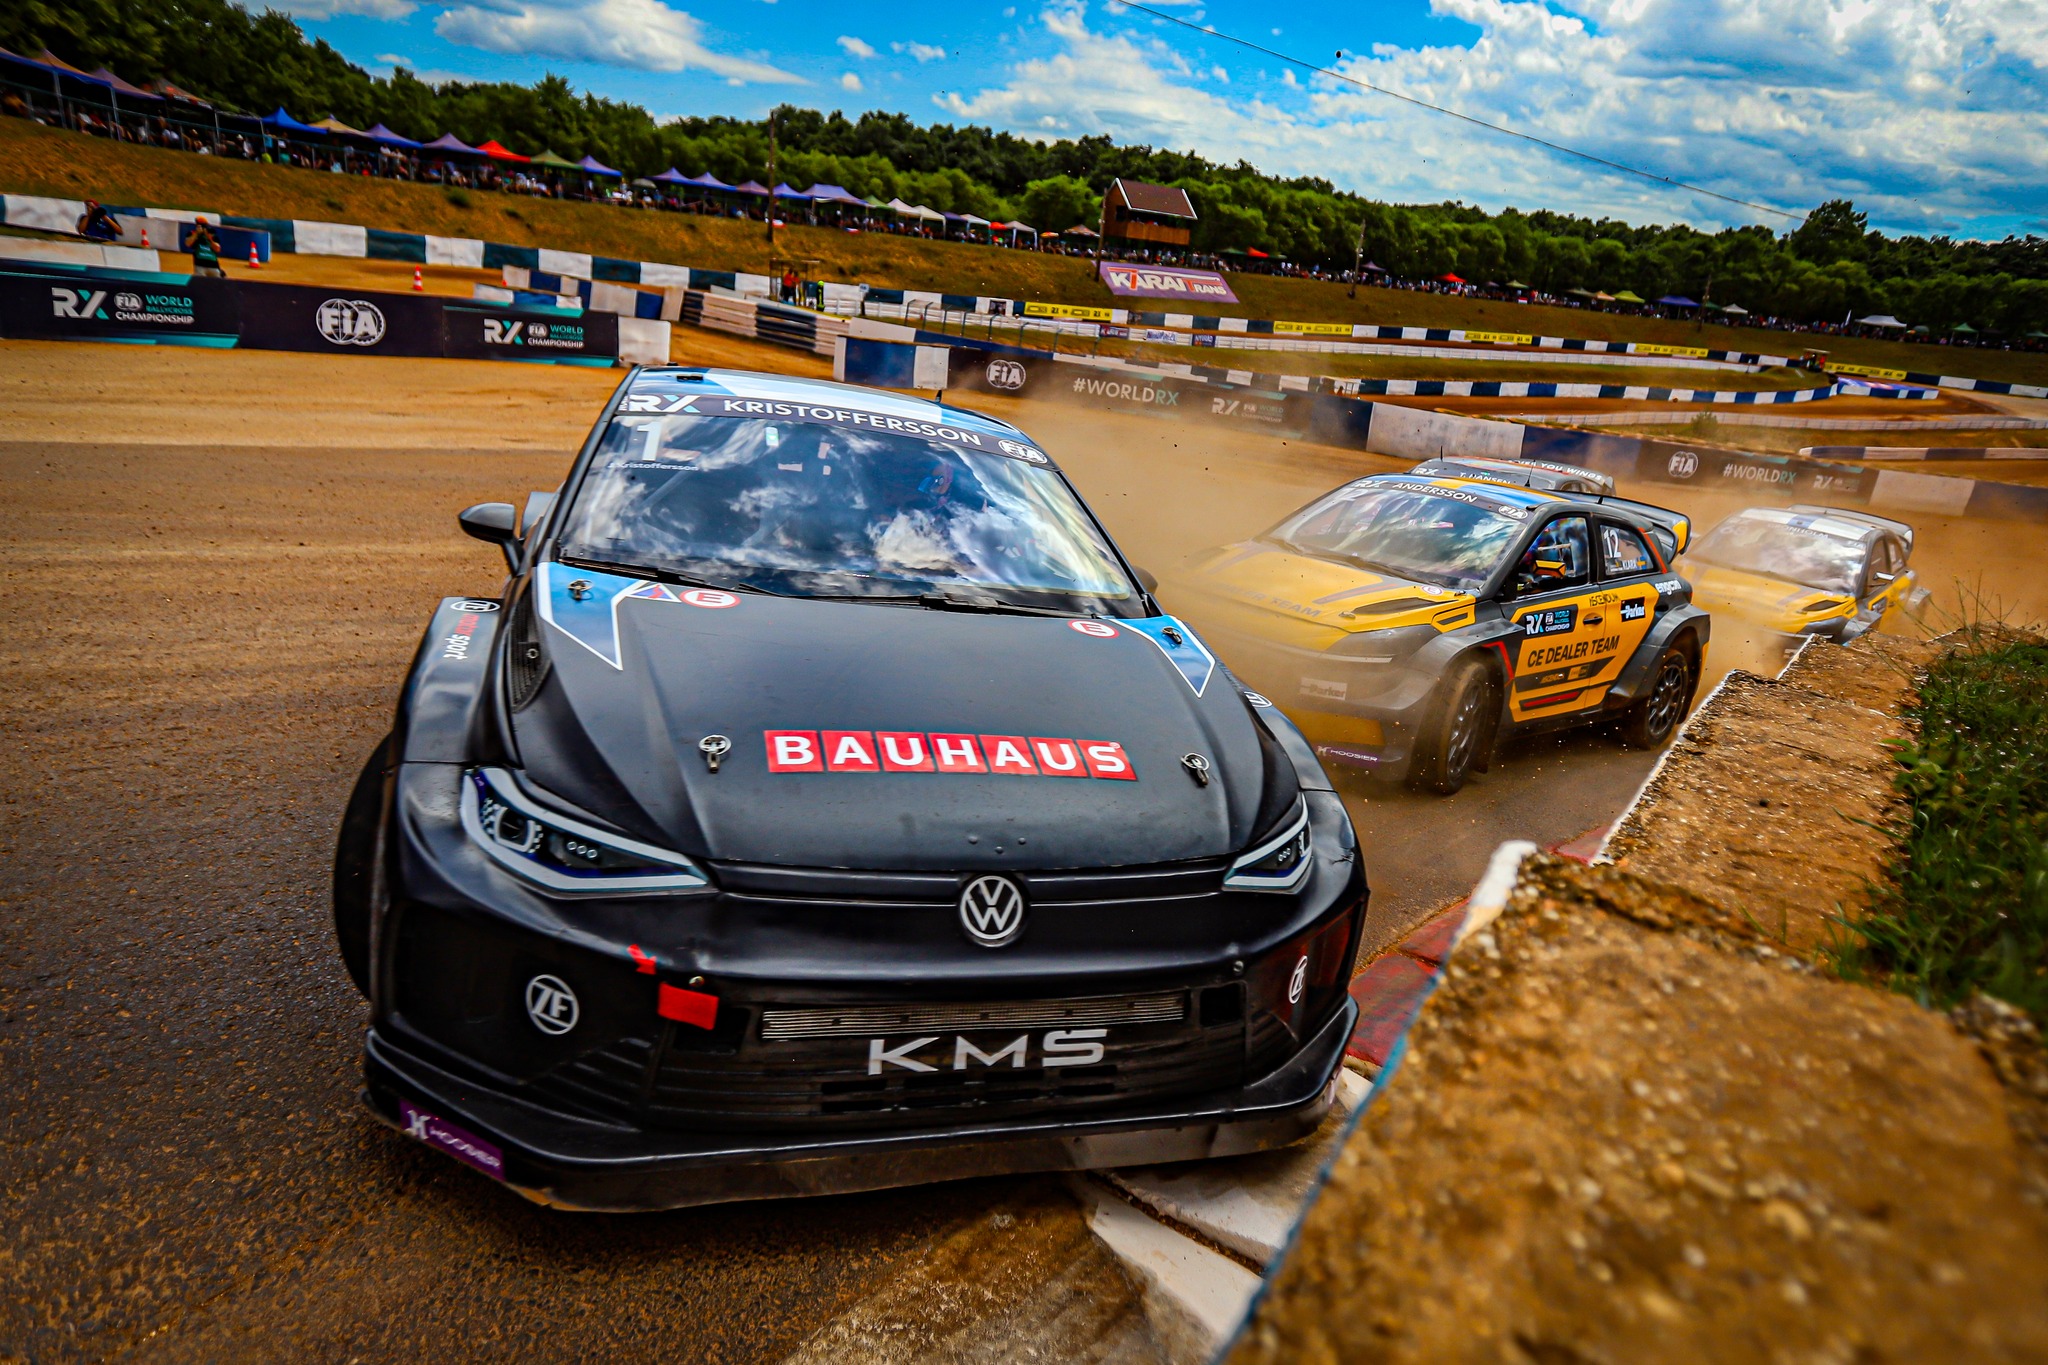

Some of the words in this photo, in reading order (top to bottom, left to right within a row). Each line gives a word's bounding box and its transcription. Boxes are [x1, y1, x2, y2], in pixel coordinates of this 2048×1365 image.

[52, 287, 109, 320] RX
[145, 294, 193, 307] WORLD
[115, 311, 195, 325] CHAMPIONSHIP
[550, 324, 583, 334] WORLD
[484, 318, 523, 345] RX
[528, 337, 584, 348] CHAMPIONSHIP
[1073, 377, 1180, 406] #WORLDRX
[1211, 397, 1240, 417] RX
[629, 394, 701, 412] RX
[724, 400, 982, 447] KRISTOFFERSSON
[636, 421, 661, 462] 1
[1541, 462, 1563, 471] YOU
[1723, 463, 1797, 485] #WORLDRX
[1392, 482, 1478, 503] ANDERSSON
[1603, 528, 1622, 558] 12
[1526, 613, 1544, 635] RX
[1527, 648, 1545, 668] CE
[1545, 640, 1590, 664] DEALER
[1591, 635, 1620, 655] TEAM
[774, 735, 1126, 773] BAUHAUS
[1330, 749, 1378, 762] HOOSIER
[527, 977, 579, 1030] ZF
[868, 1028, 1108, 1076] KMS
